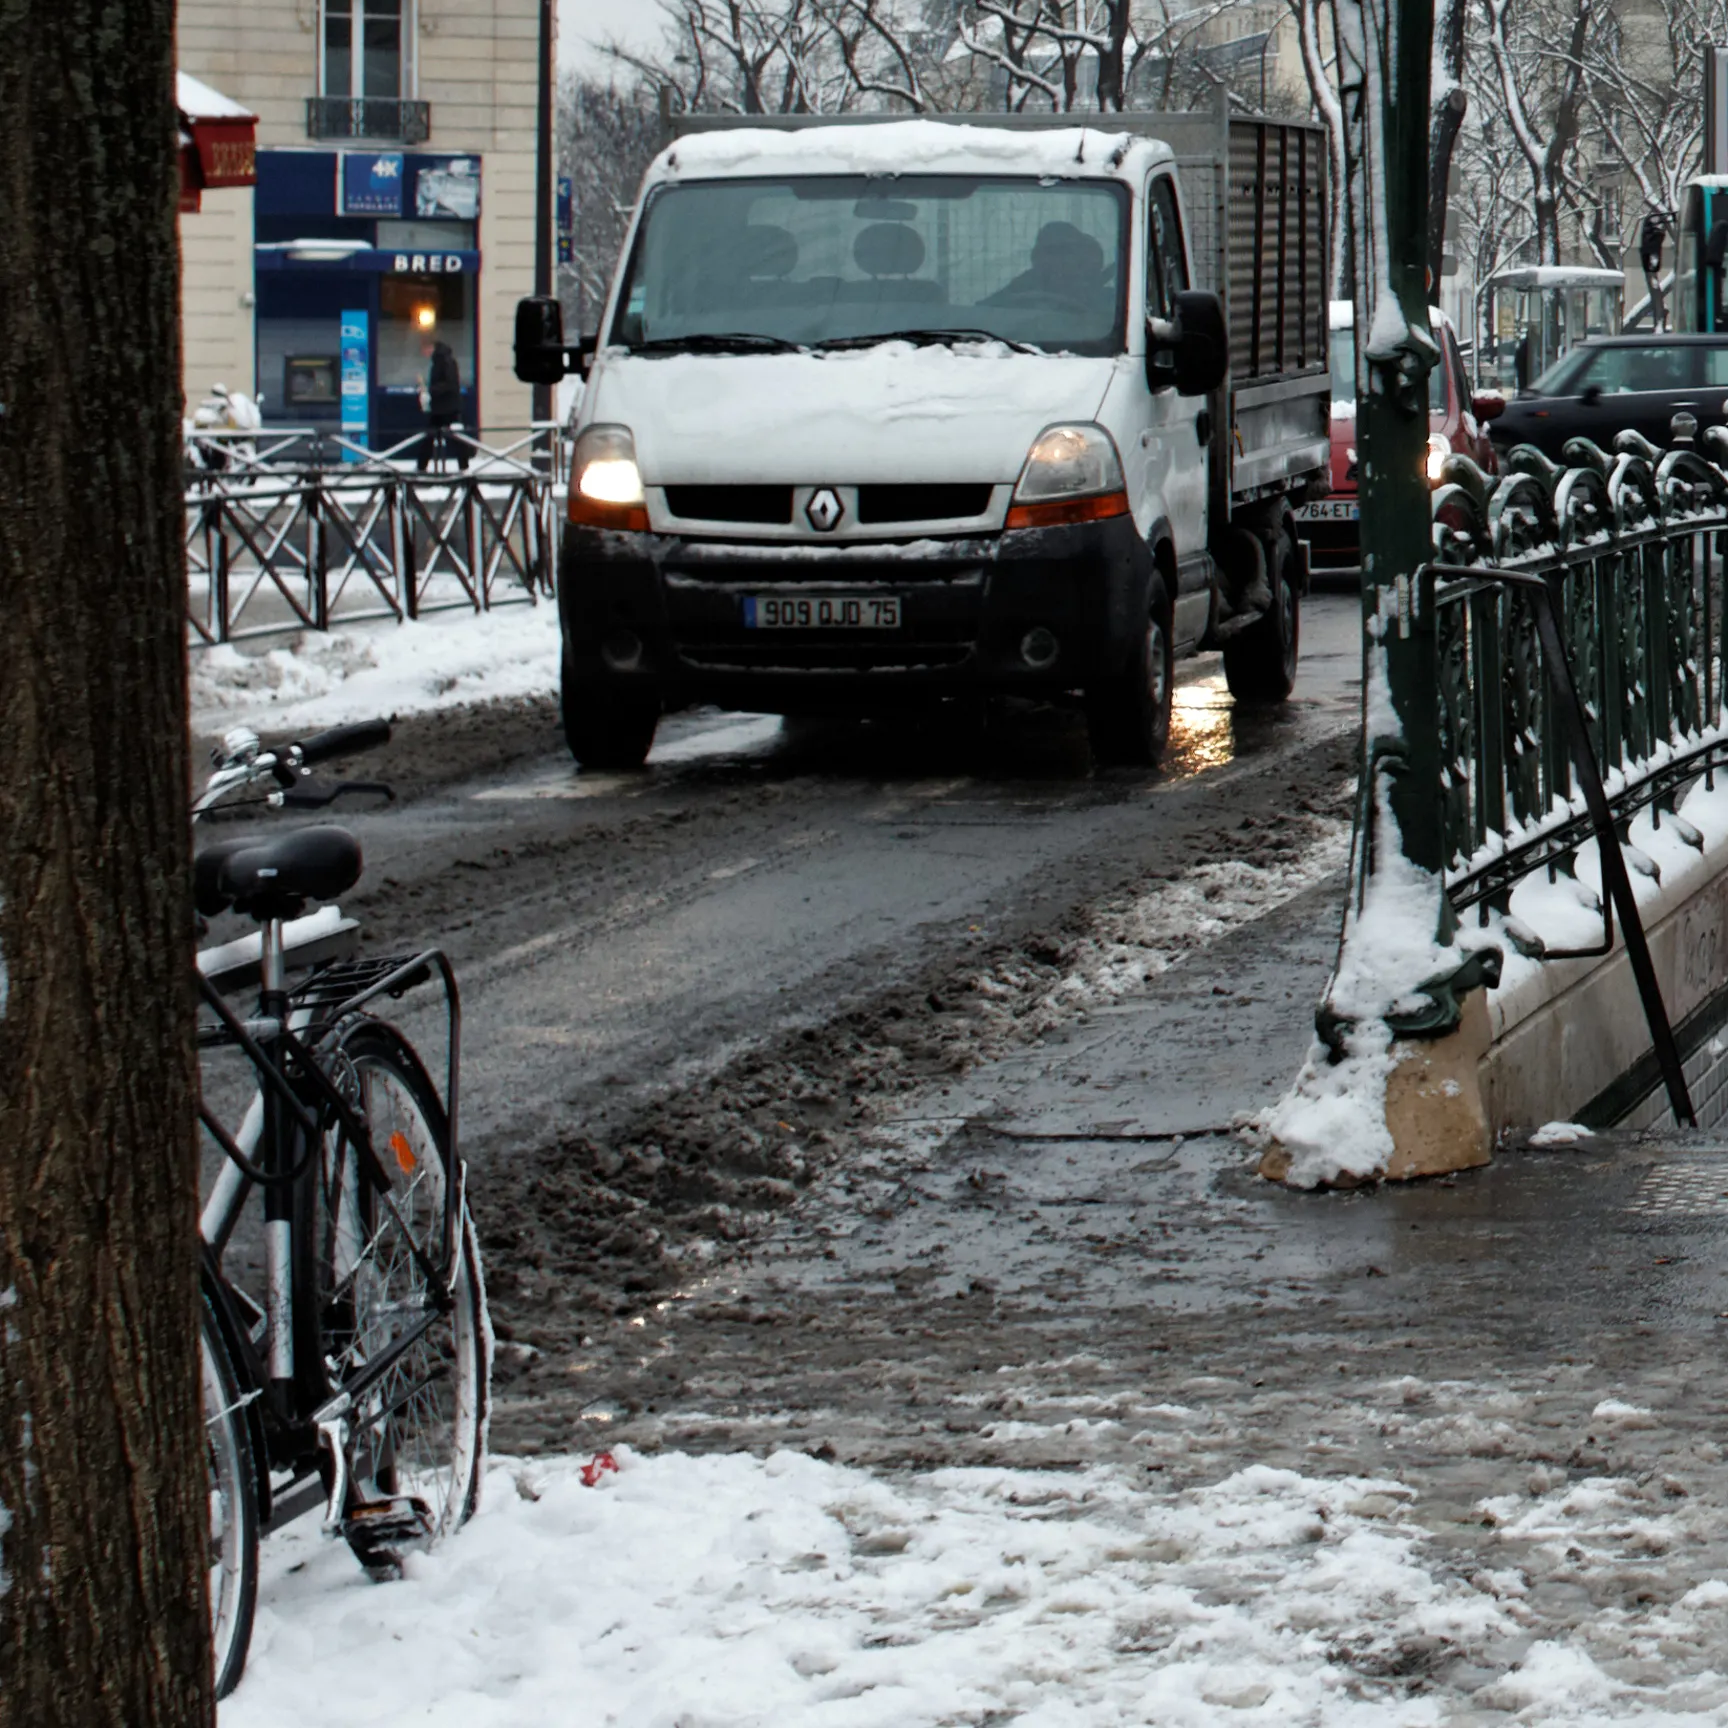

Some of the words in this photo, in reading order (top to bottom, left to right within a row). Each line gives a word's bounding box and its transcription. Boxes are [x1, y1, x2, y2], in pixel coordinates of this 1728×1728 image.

[394, 254, 462, 272] BRED
[765, 600, 811, 626] 909
[818, 600, 861, 626] QJD
[868, 600, 897, 626] 75
